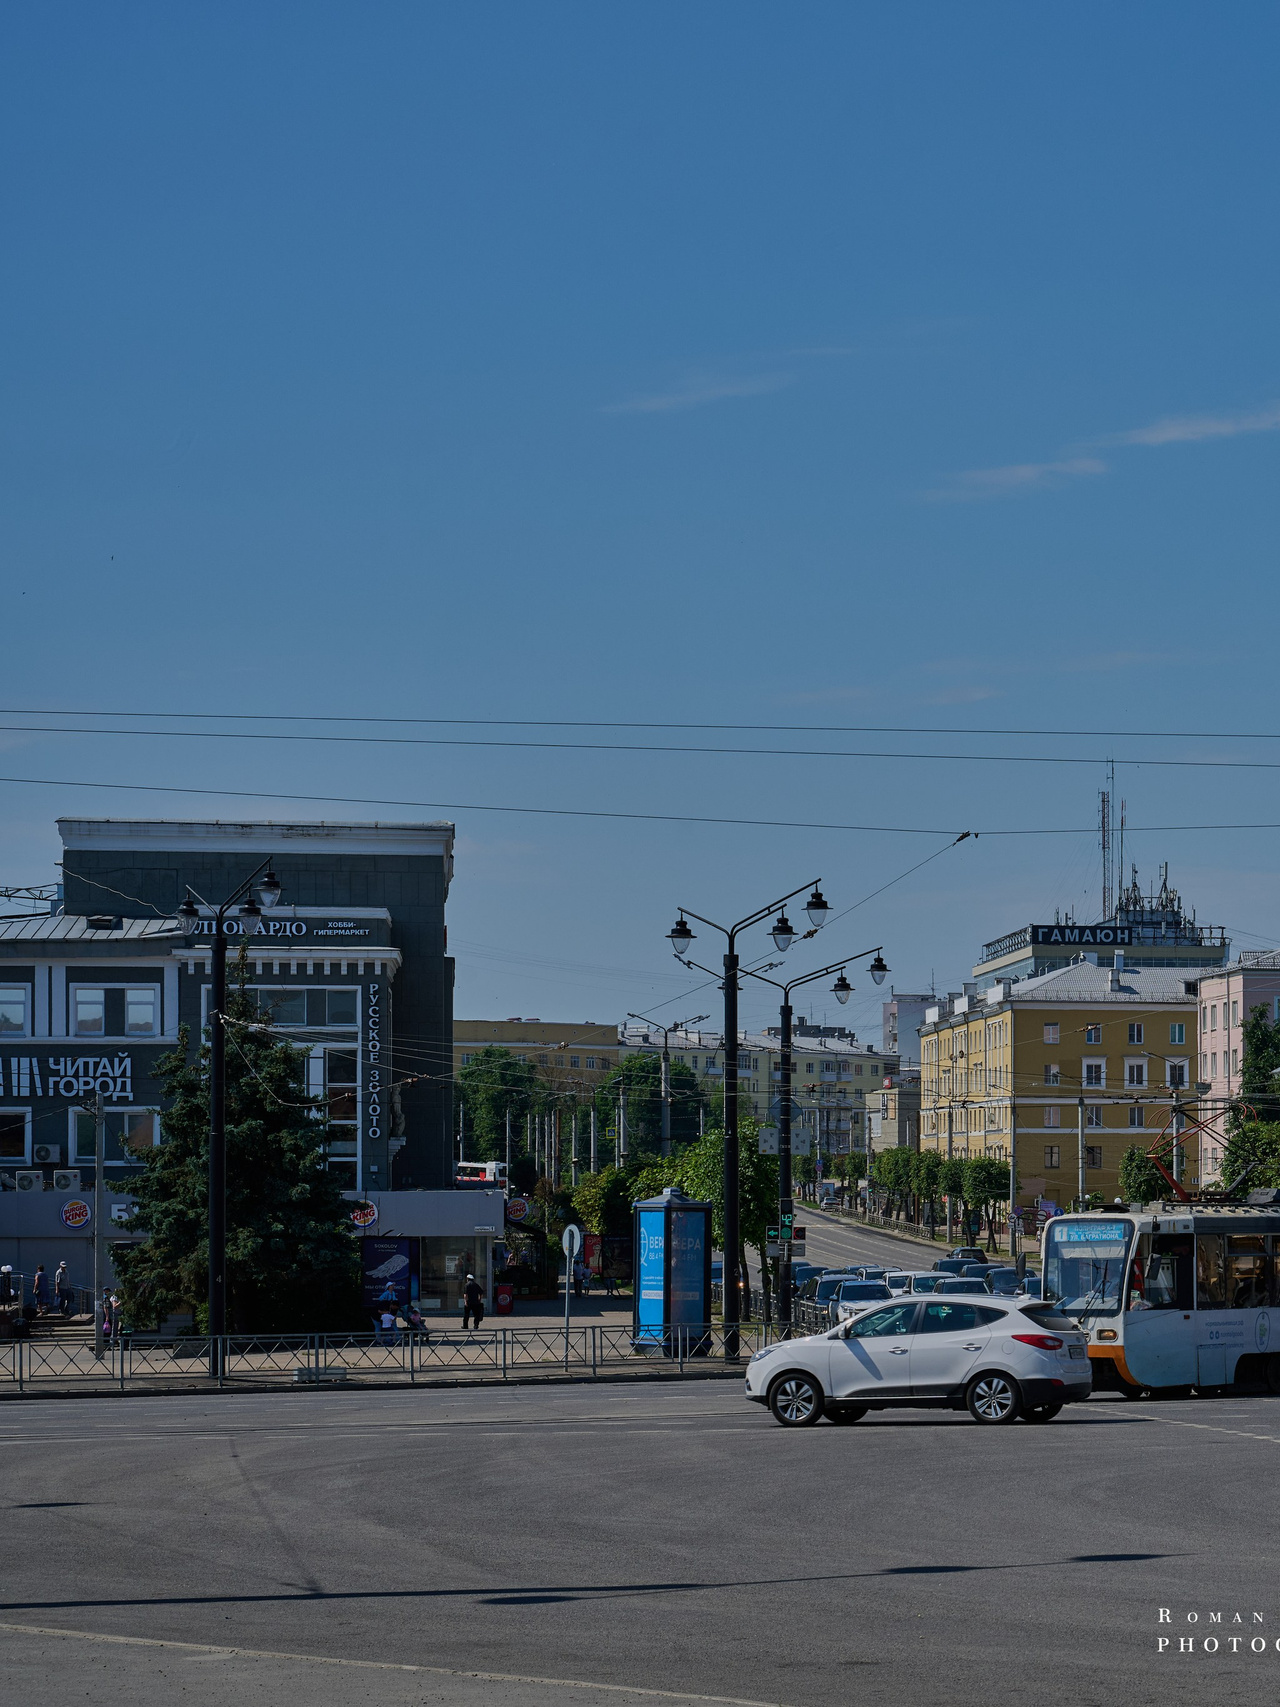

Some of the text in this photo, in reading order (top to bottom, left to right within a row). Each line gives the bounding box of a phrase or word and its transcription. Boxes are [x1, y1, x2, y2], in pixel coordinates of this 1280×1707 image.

[327, 920, 357, 928] ХОББИ-
[1038, 928, 1129, 943] ГАМАЮН
[368, 983, 381, 1063] РУССКОЕ
[49, 1052, 132, 1077] ЧИТАЙ
[49, 1077, 134, 1101] ГОРОД
[368, 1070, 382, 1139] ЗОЛОТО
[64, 1204, 87, 1216] BURGER
[64, 1209, 88, 1223] KING
[352, 1209, 375, 1222] KING
[508, 1206, 527, 1216] KING
[1058, 1228, 1064, 1240] 1
